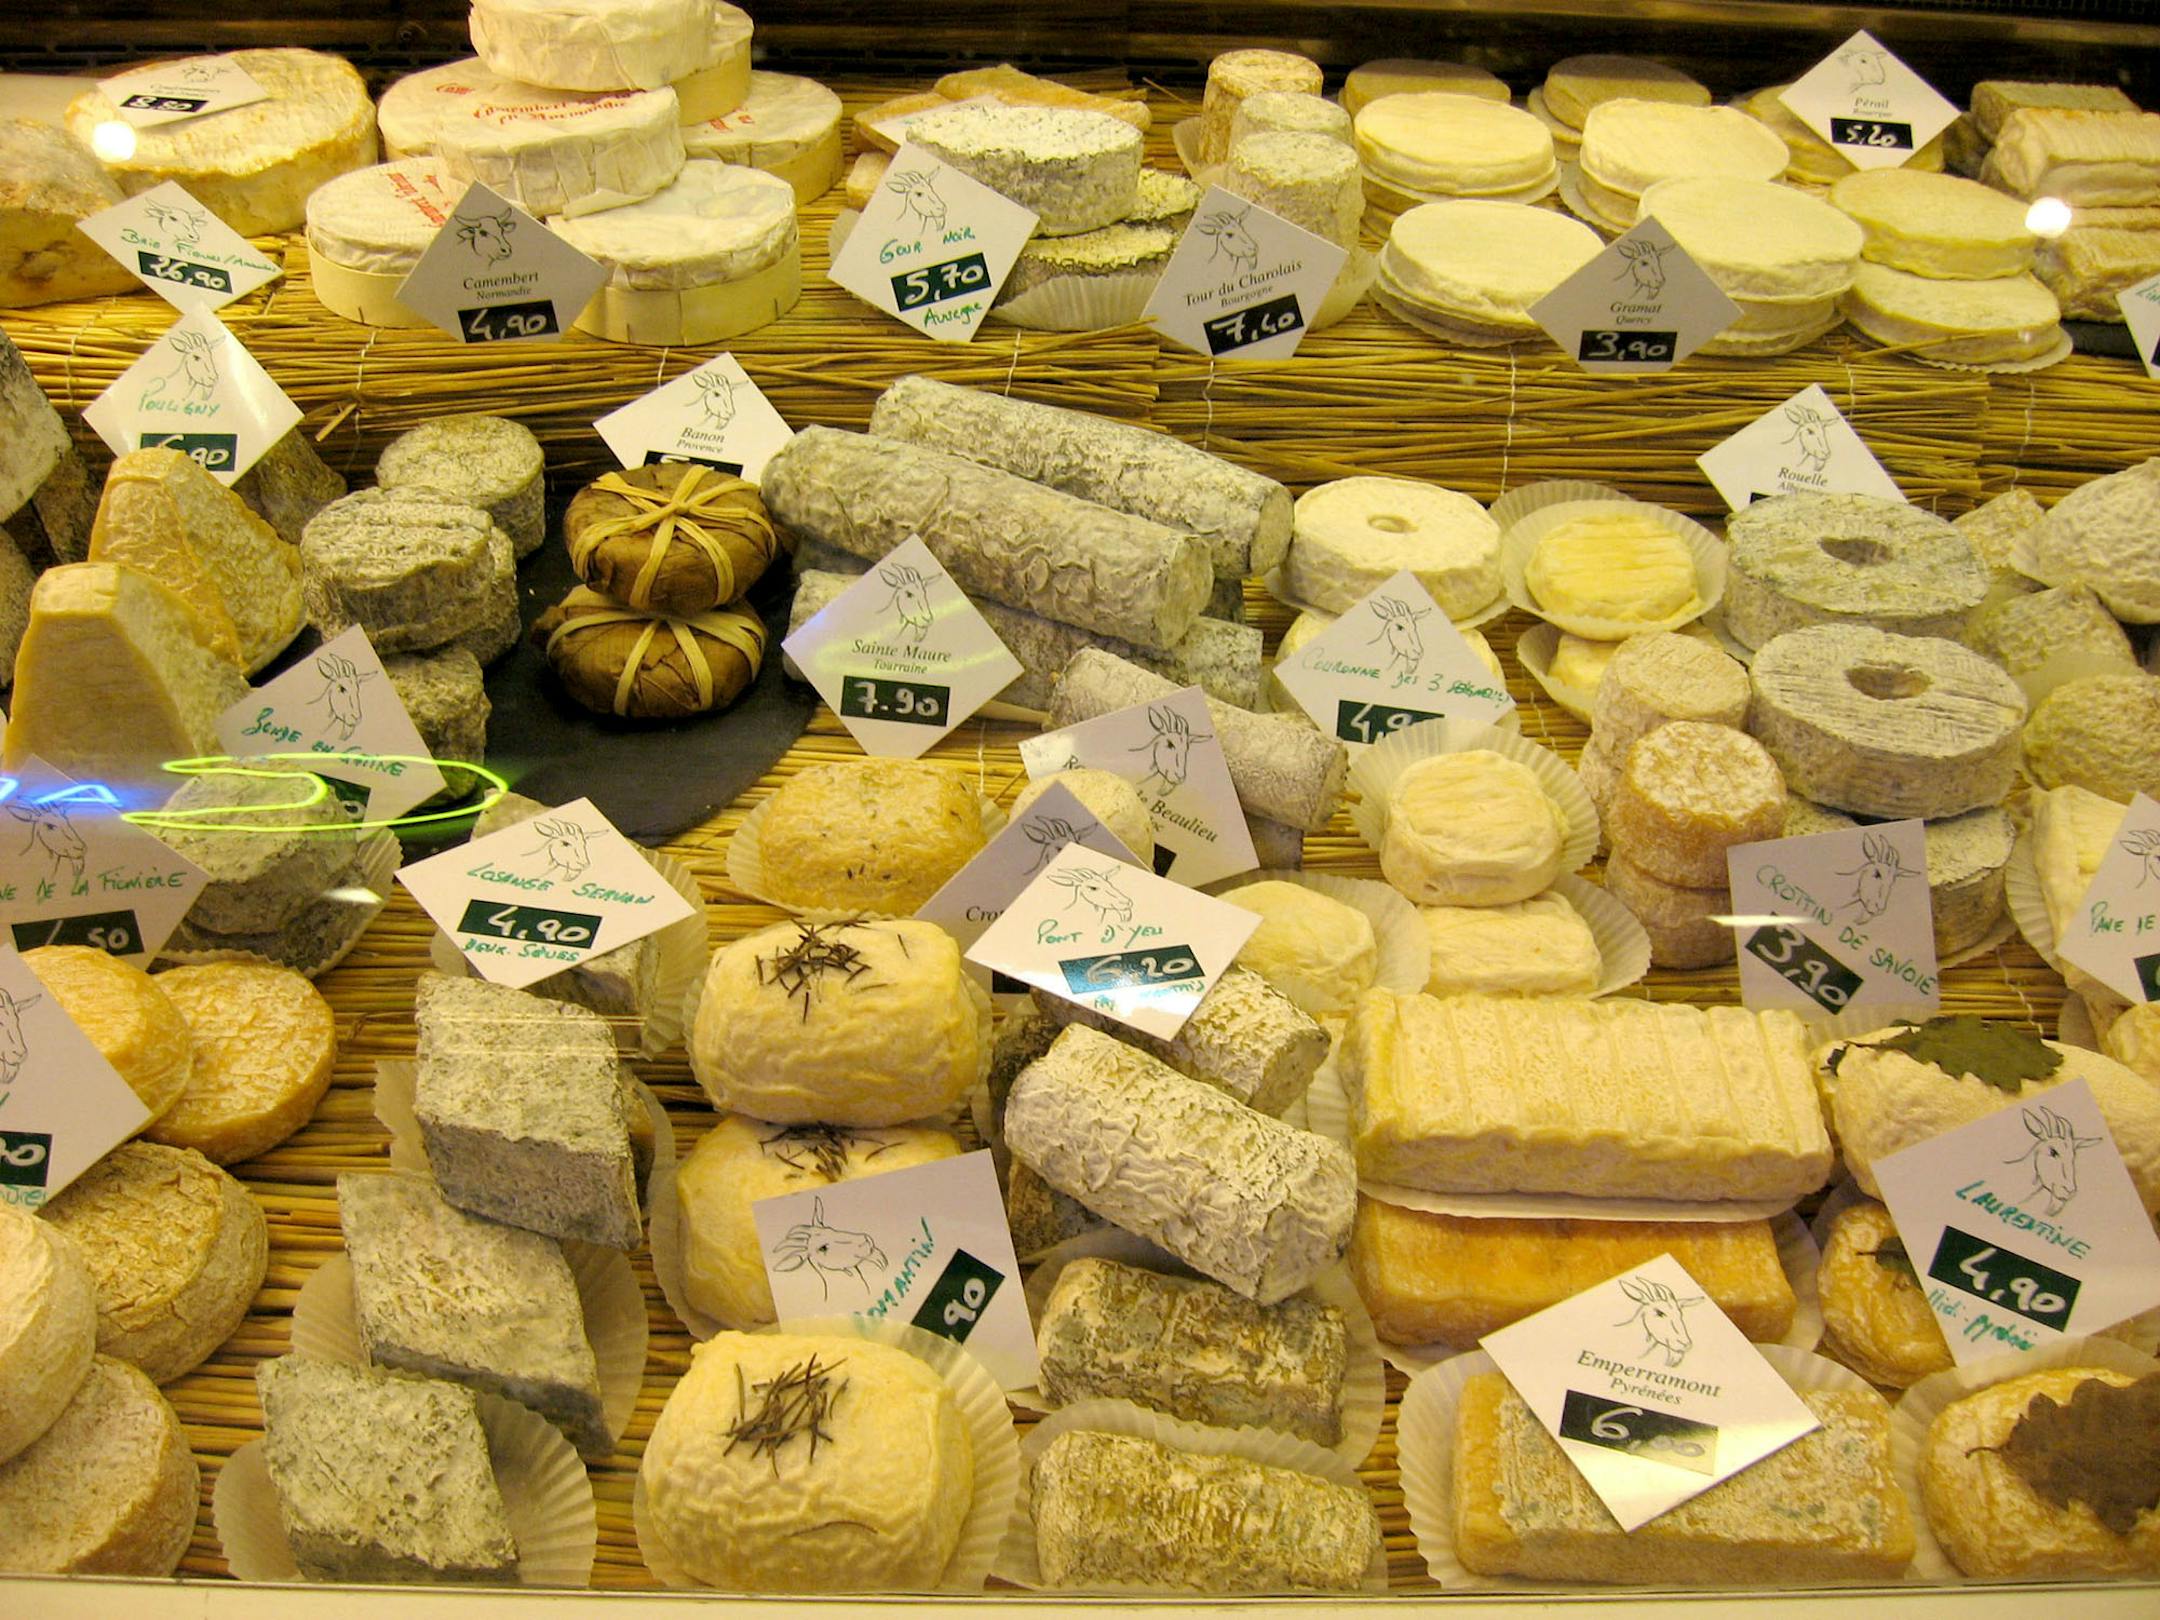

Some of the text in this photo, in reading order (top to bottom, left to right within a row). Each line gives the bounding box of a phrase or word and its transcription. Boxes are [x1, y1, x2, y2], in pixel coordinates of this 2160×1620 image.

[1855, 97, 1889, 109] Pérail
[463, 272, 539, 290] Camembert
[476, 286, 532, 301] Normandie
[904, 263, 985, 306] 5,70
[1184, 259, 1304, 308] Tour du Charolais
[1220, 284, 1275, 308] Bourgogne
[1610, 301, 1662, 314] Gramat
[468, 308, 547, 341] 4,90
[1210, 312, 1297, 343] 7,40
[1588, 331, 1668, 361] 3,90
[675, 438, 725, 454] Provence
[681, 427, 726, 443] Banon
[1777, 466, 1829, 487] Rouelle
[851, 638, 952, 663] Sainte Maure
[874, 658, 928, 675] Tourraine
[1427, 673, 1443, 691] 3
[1149, 799, 1219, 844] Beaulieu
[487, 906, 592, 943] 4,90
[1756, 864, 1938, 996] CROTTIN DE SAVOIE
[1958, 1247, 2067, 1313] 4,90
[1577, 1349, 1722, 1398] Emperramont
[1610, 1377, 1682, 1405] Pyrénées
